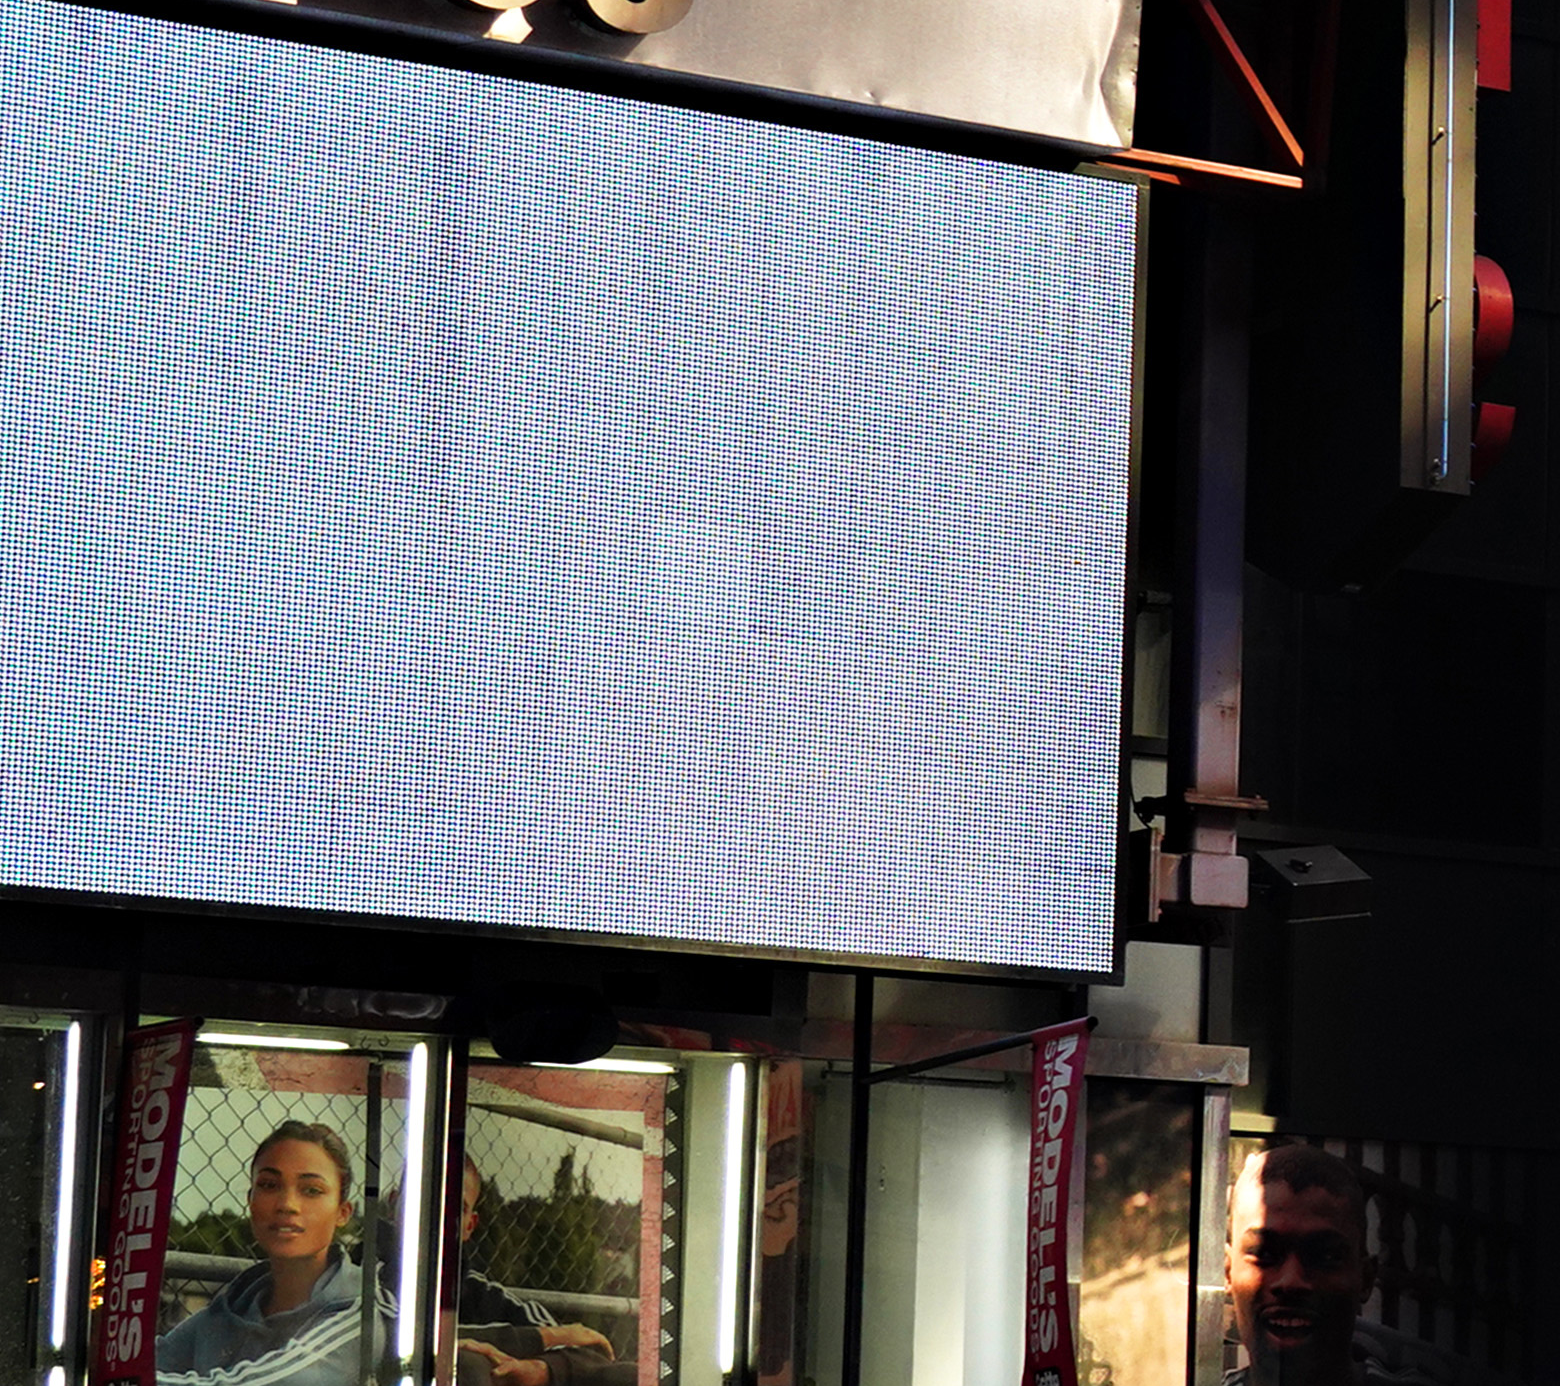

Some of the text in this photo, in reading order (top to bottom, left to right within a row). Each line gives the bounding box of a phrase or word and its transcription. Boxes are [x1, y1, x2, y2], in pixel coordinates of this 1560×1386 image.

[104, 1036, 157, 1364] SPORTING GOODS
[118, 1033, 183, 1364] MODELL'S
[1031, 1040, 1055, 1206] SPORTING
[1037, 1034, 1080, 1354] MODELL'S
